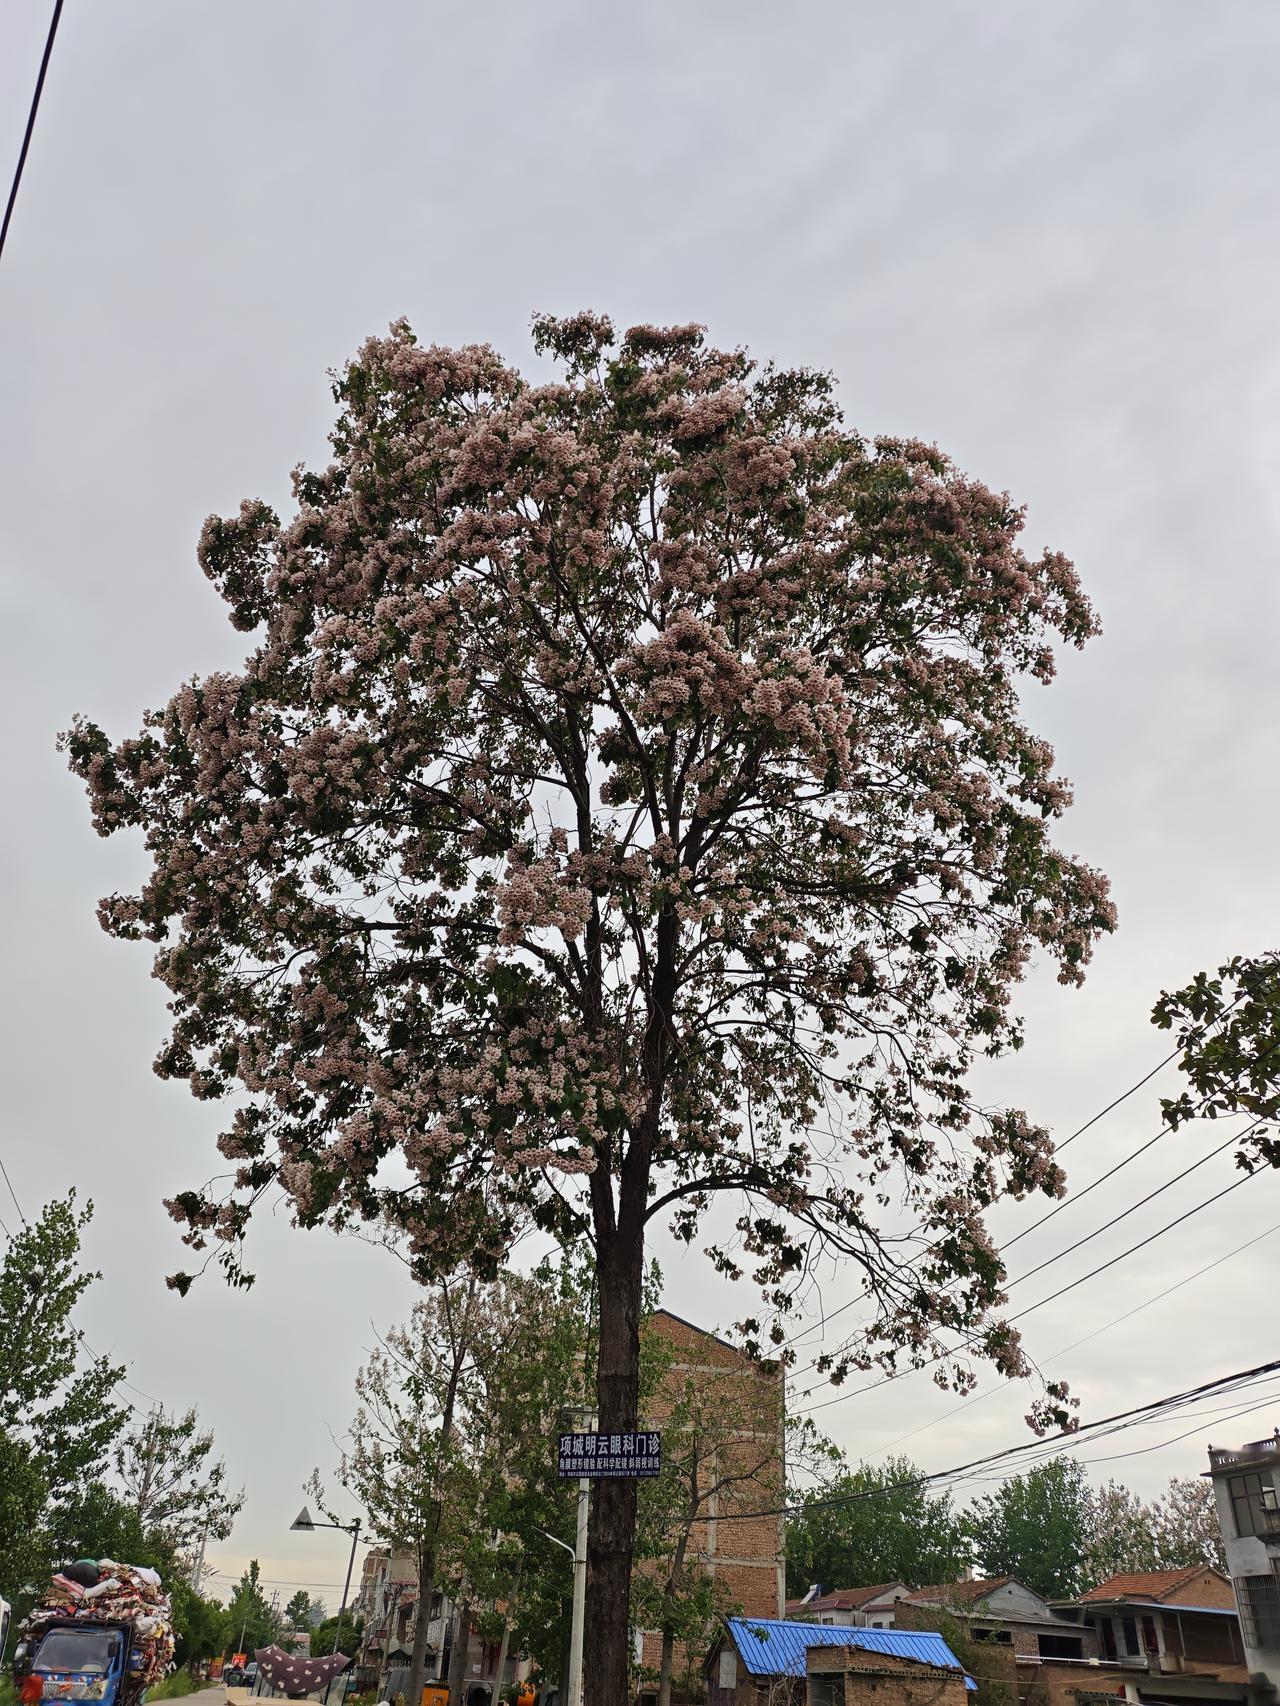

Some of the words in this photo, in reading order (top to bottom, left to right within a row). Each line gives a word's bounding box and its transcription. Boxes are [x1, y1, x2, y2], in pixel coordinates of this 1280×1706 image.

[560, 1434, 660, 1456] 项城明云眼科门诊
